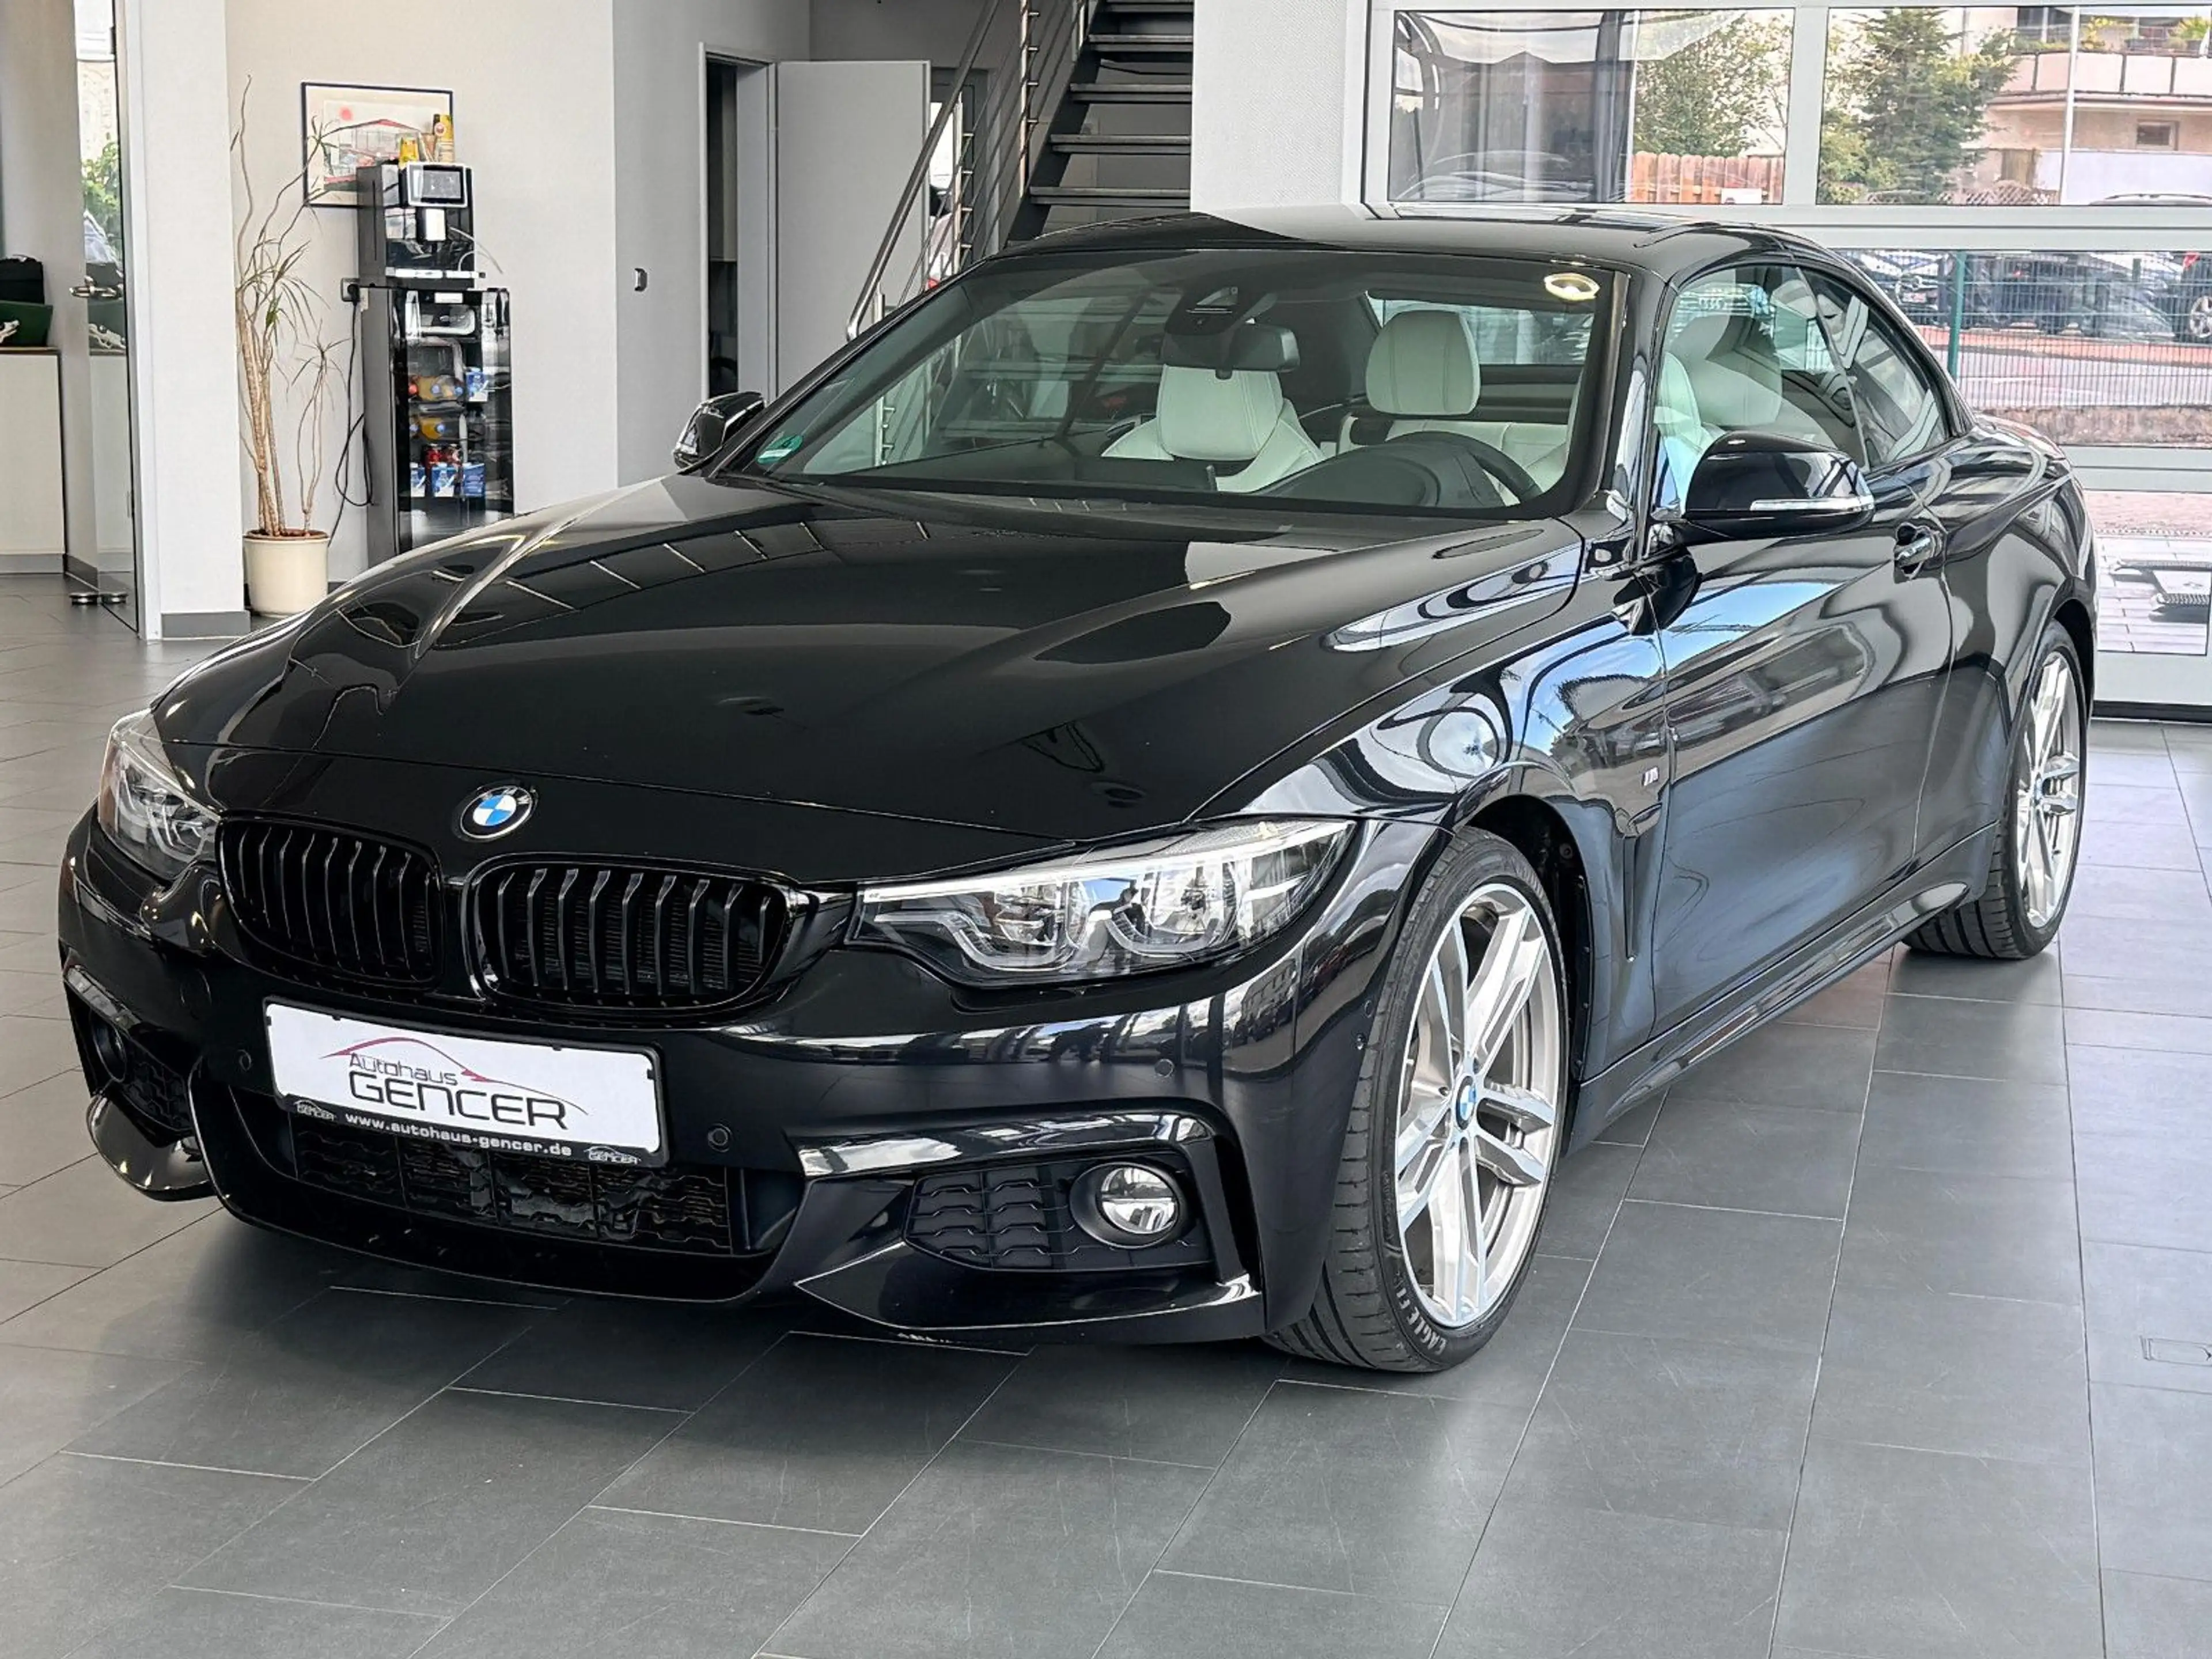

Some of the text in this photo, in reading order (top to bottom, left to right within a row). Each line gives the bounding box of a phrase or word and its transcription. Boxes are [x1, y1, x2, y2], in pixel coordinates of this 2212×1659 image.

[350, 1053, 459, 1086] Autohaus
[349, 1071, 569, 1130] GENCER
[346, 1112, 572, 1156] www.autohaus-gencer.de
[1407, 1306, 1448, 1355] EAGLE
